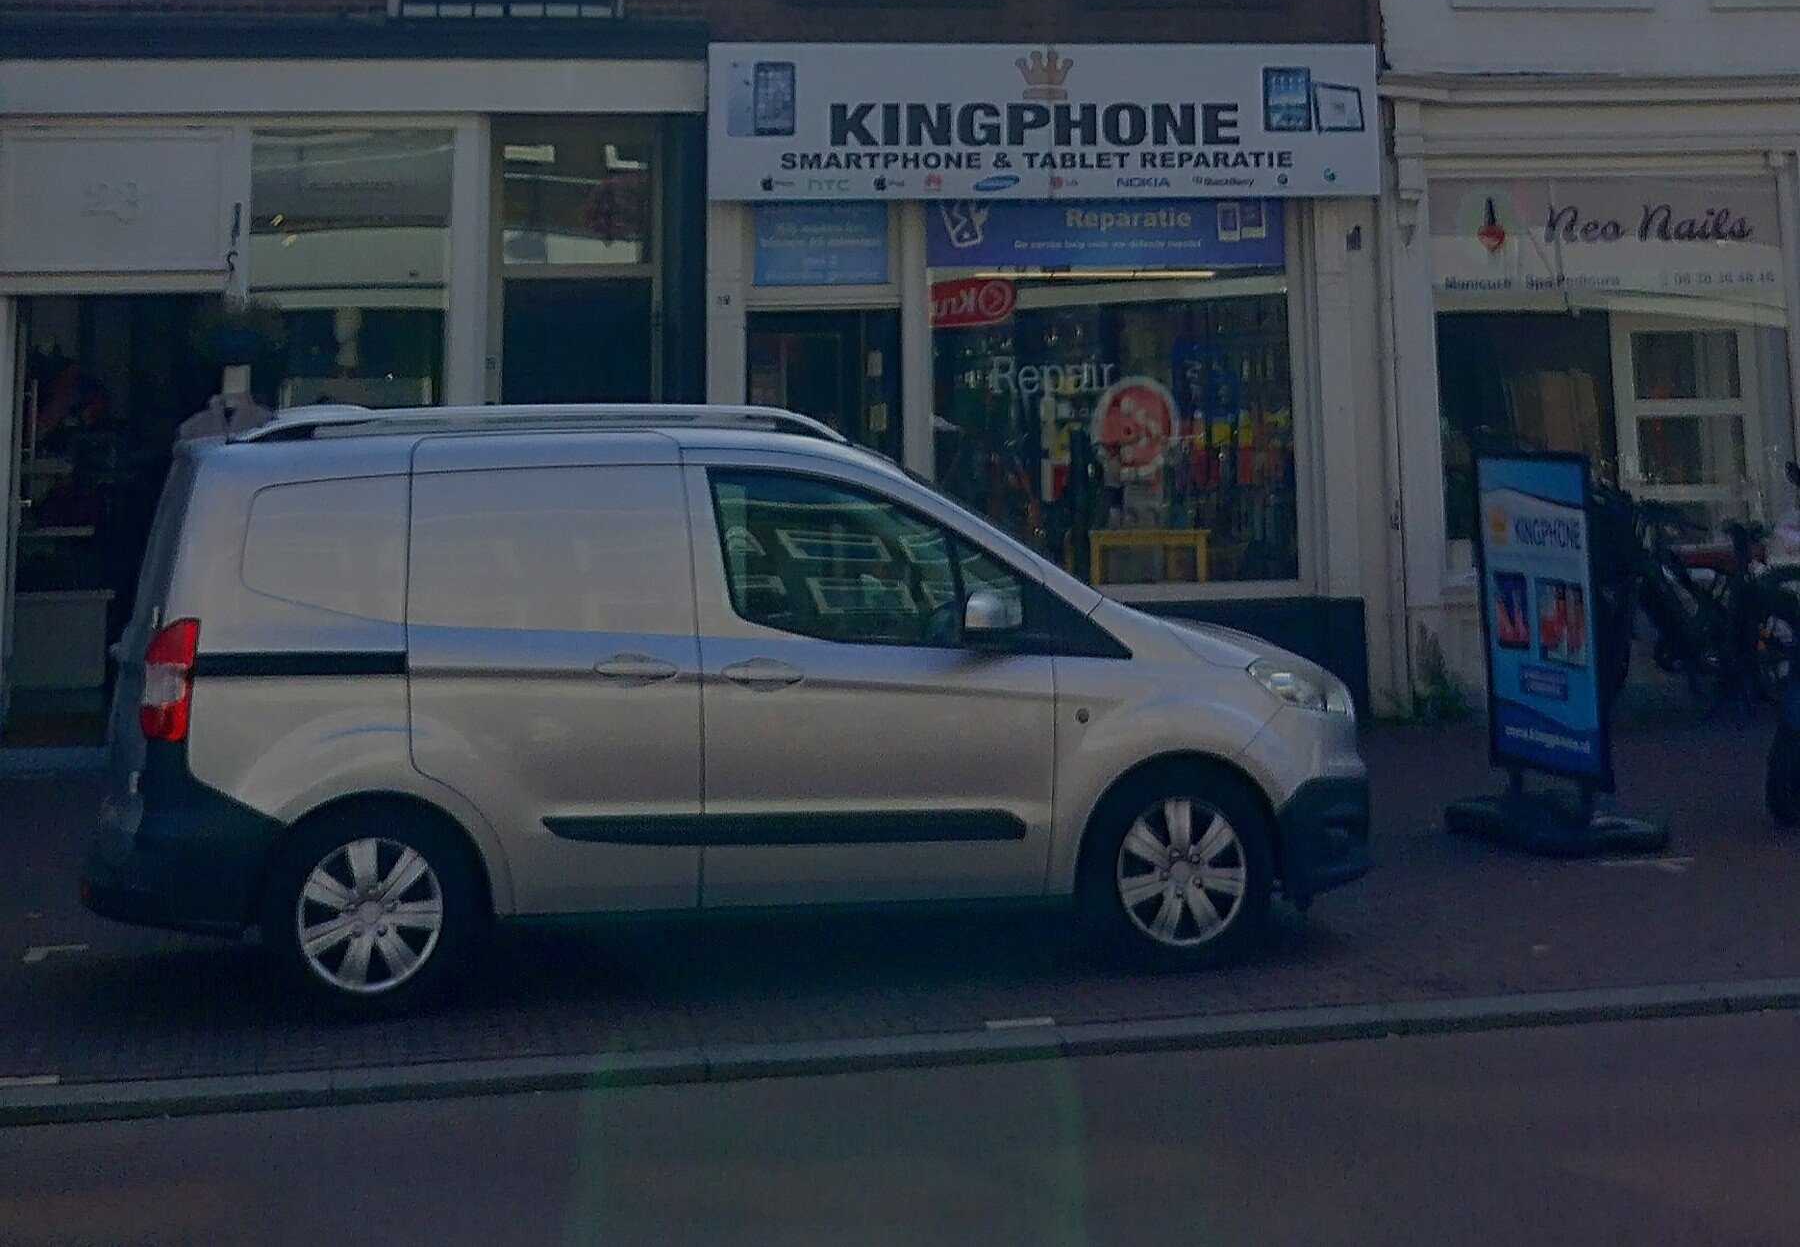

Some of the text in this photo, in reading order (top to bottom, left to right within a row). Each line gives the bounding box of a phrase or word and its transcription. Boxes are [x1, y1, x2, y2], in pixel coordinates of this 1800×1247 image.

[828, 102, 1241, 147] KINGPHONE
[780, 150, 1294, 171] SMARTPHONE & TABLET REPARATIE
[1116, 176, 1171, 188] NOKIA
[1064, 207, 1192, 234] Reparatie
[1637, 203, 1753, 243] Nails
[989, 354, 1116, 399] Repair
[1514, 516, 1581, 550] KINGPHONE
